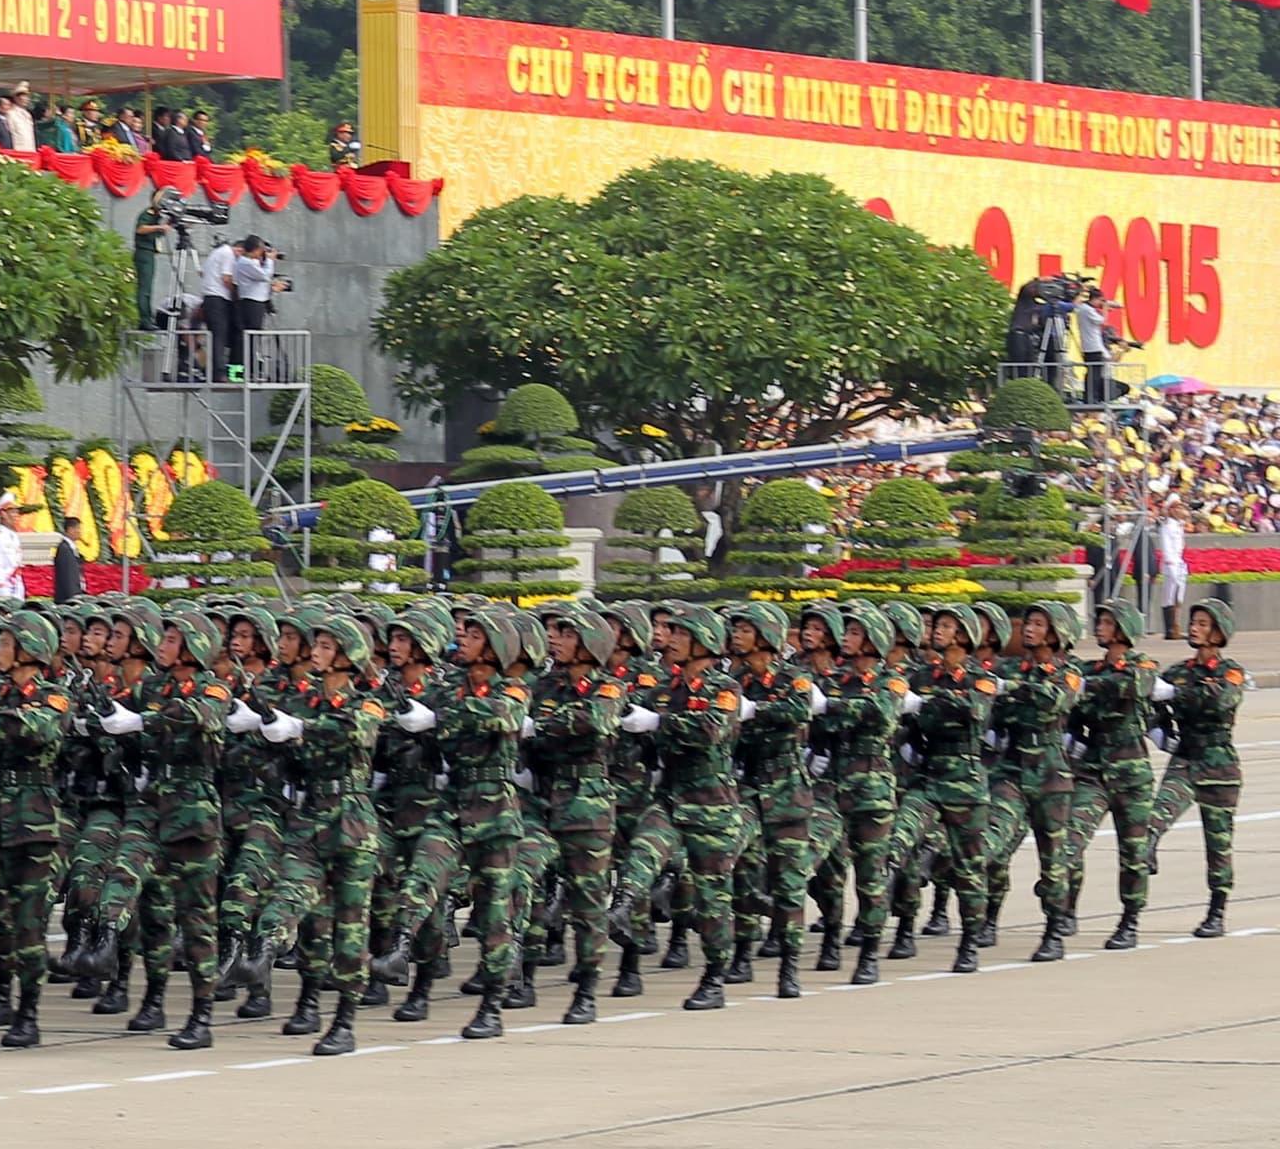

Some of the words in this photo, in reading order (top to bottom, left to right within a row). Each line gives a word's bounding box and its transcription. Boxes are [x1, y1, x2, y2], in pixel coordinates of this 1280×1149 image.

[507, 36, 573, 98] CHỦ
[582, 51, 660, 112] TỊCH
[668, 46, 713, 113] HỒ
[721, 63, 776, 119] CHÍ
[782, 74, 864, 128] MINH
[868, 77, 899, 132] VĨ
[904, 88, 953, 146] ĐẠI
[957, 83, 1028, 145] SỐNG
[1032, 98, 1083, 152] MÃI
[1086, 111, 1172, 160] TRONG
[1084, 214, 1223, 349] 2015
